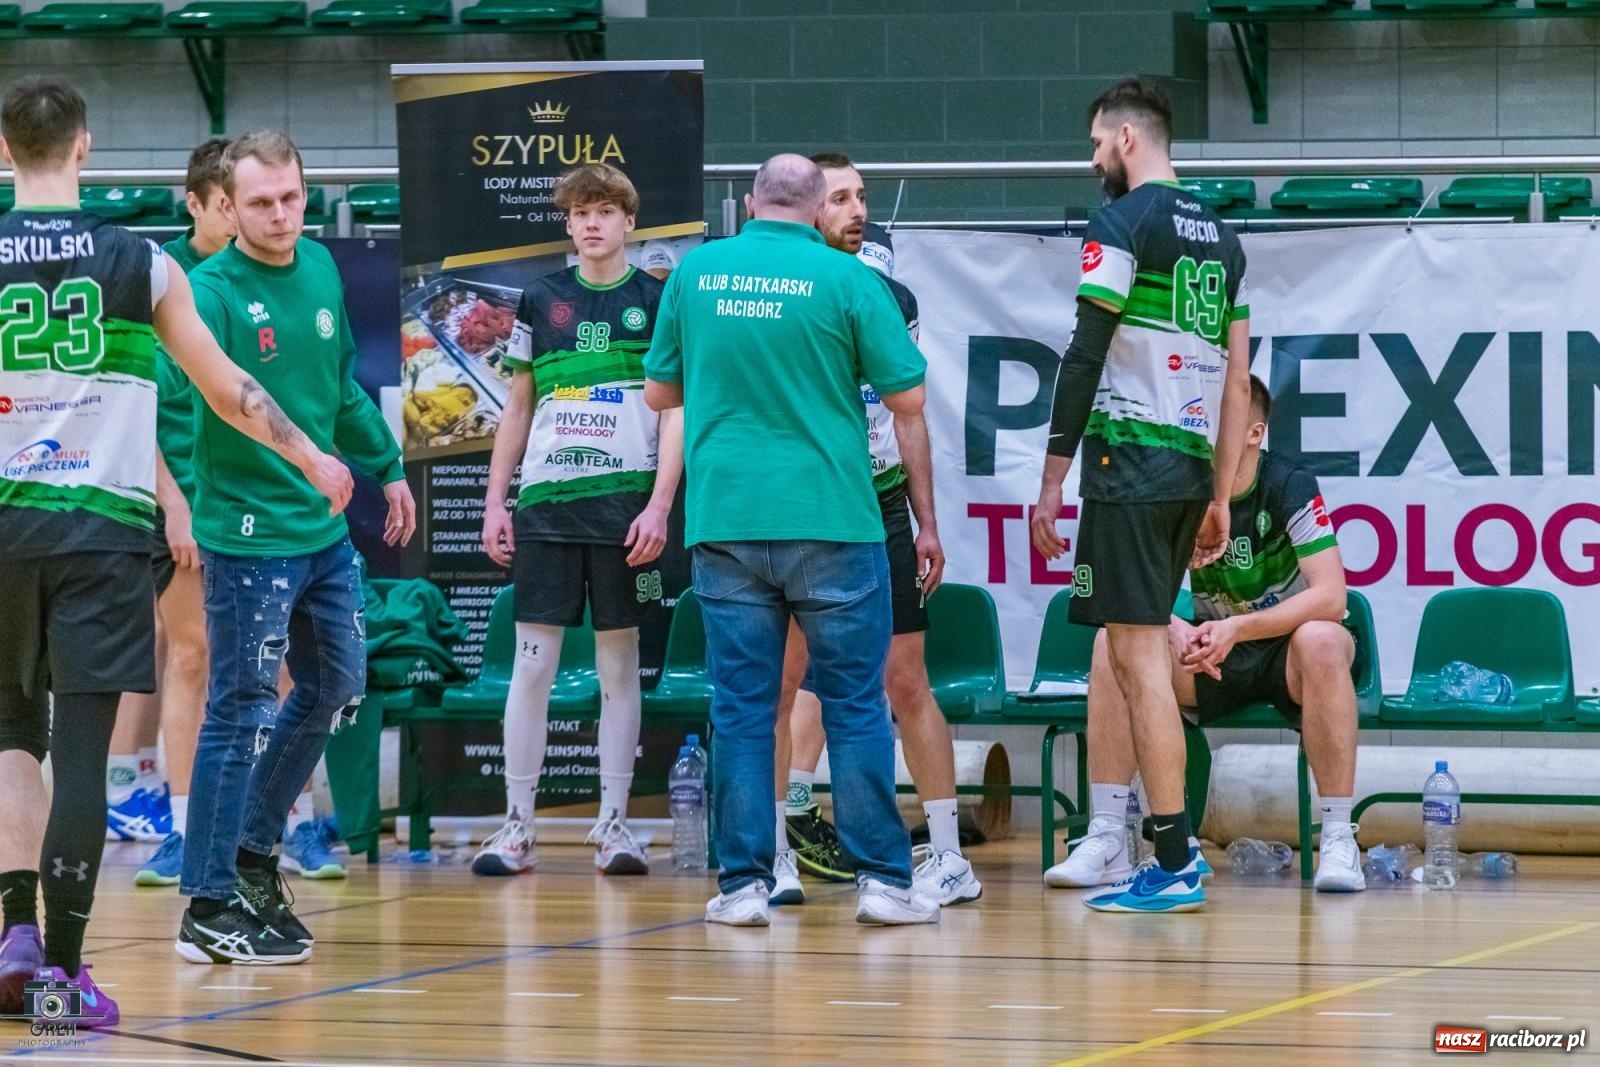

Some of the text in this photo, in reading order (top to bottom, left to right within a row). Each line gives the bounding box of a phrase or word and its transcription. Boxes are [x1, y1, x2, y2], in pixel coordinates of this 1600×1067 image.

[472, 133, 625, 165] SZYPUŁA
[484, 177, 517, 189] LODY
[500, 193, 557, 204] Naturalni
[527, 212, 544, 222] Od
[0, 231, 95, 264] SKULSKI
[698, 274, 814, 297] KLUB SIATKARSKI
[1172, 254, 1227, 339] 69
[717, 298, 783, 319] RACIBÓRZ
[0, 276, 104, 371] 23
[259, 327, 277, 352] R
[576, 321, 611, 352] 98
[965, 332, 1600, 477] PEXI
[556, 412, 617, 428] PIVEXIN
[555, 427, 616, 438] TECHNOLOGY
[240, 514, 256, 536] 8
[636, 570, 662, 603] 98
[547, 720, 581, 732] NTAKT
